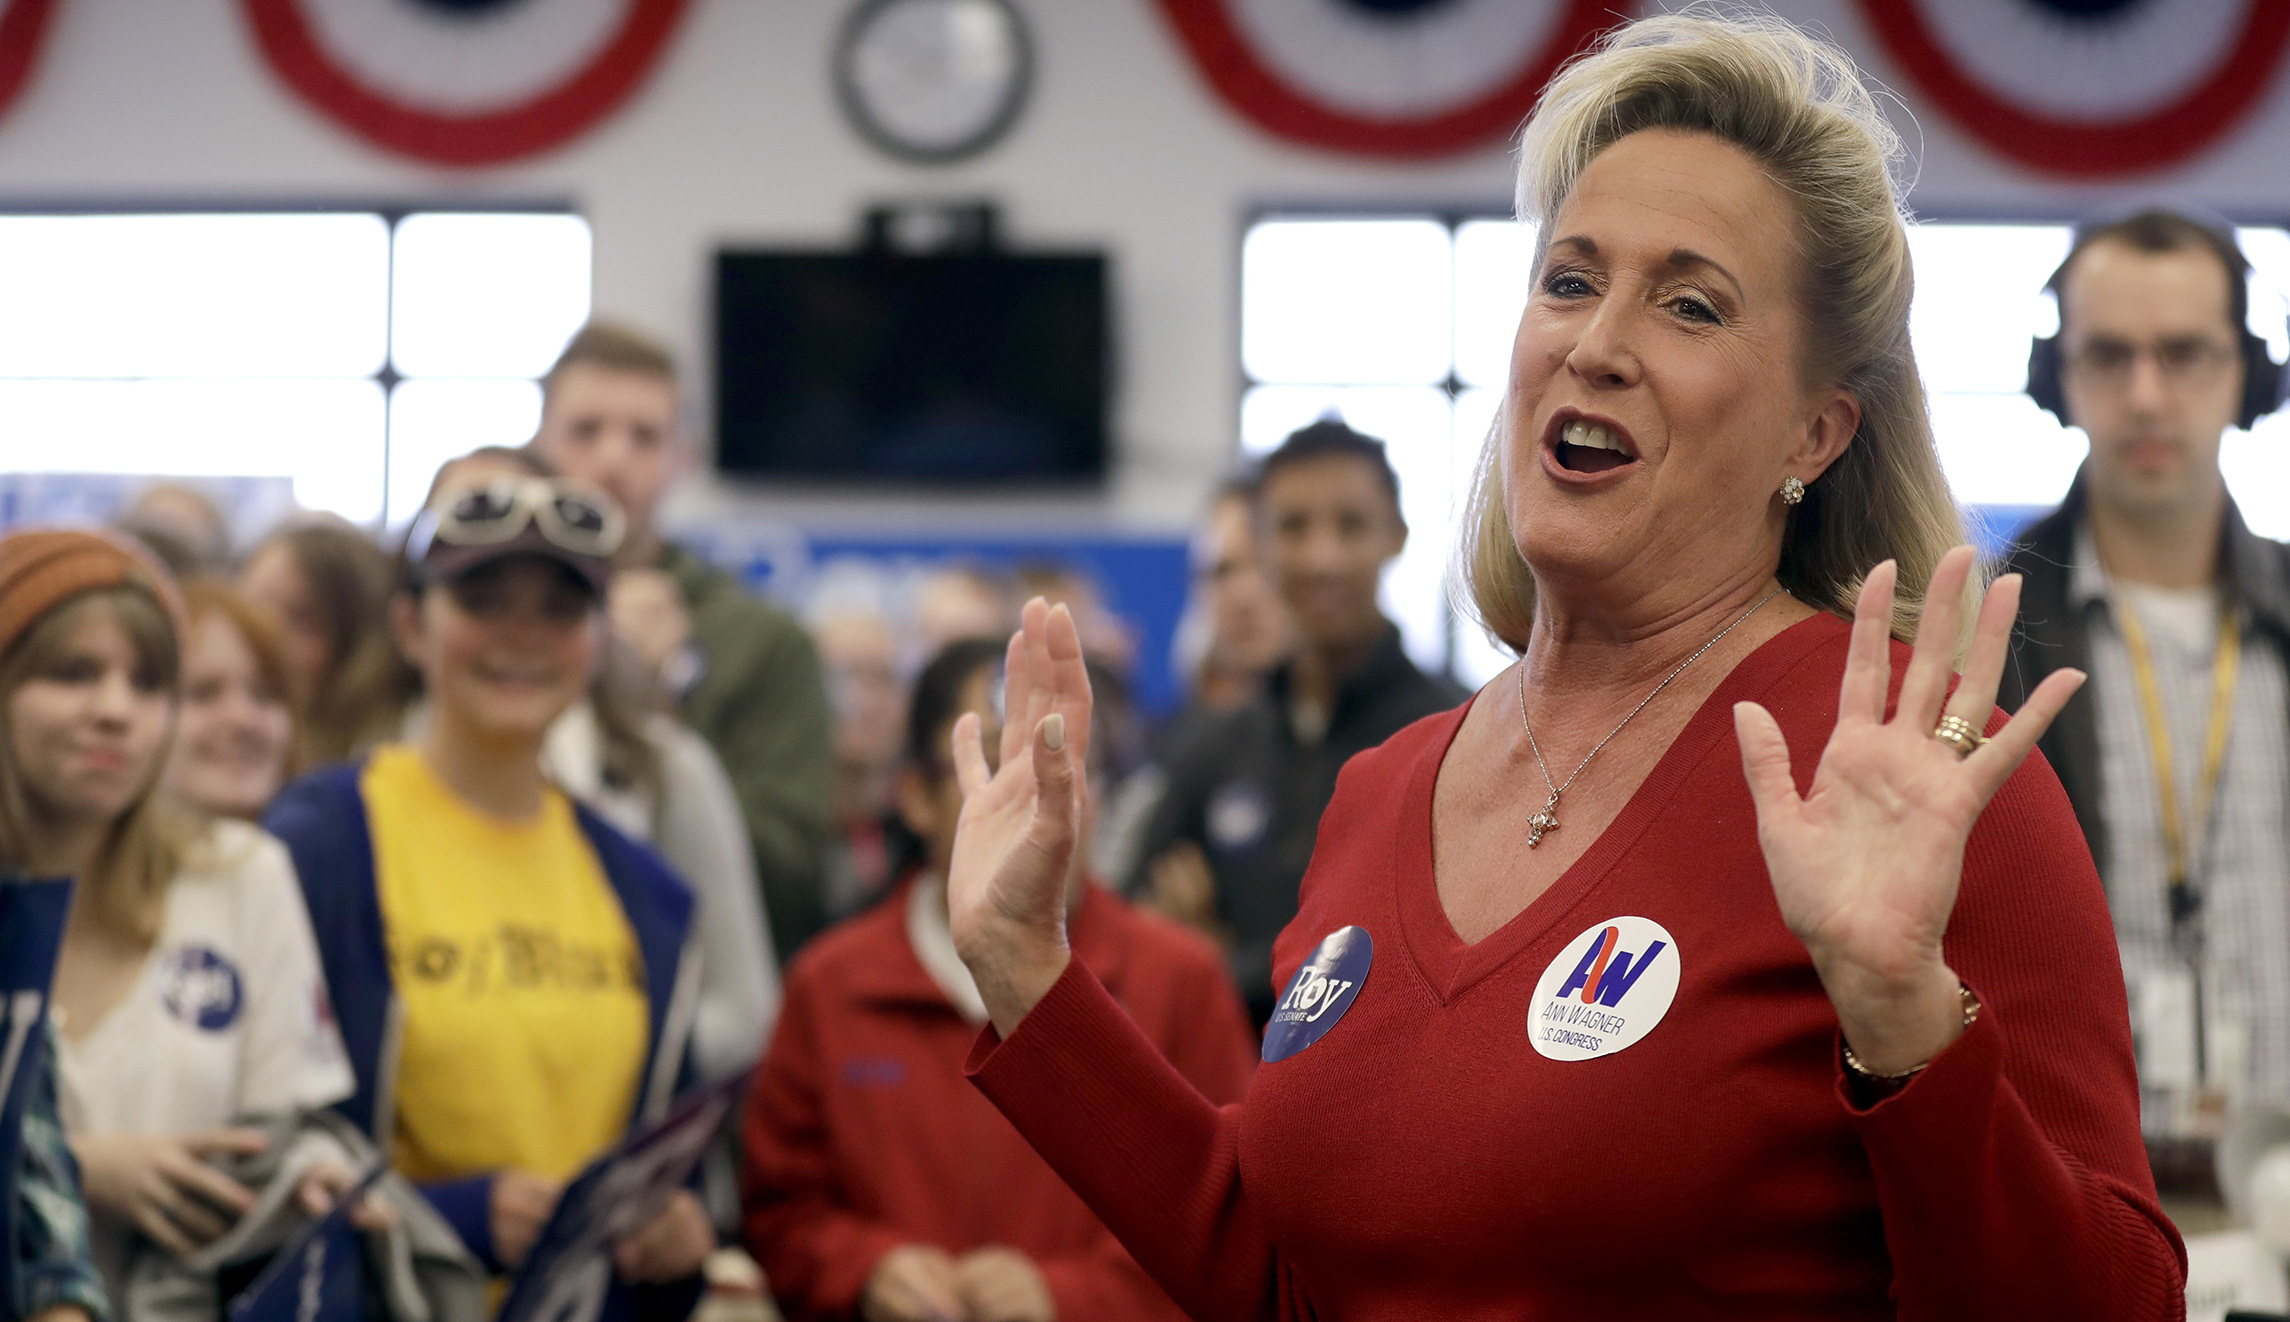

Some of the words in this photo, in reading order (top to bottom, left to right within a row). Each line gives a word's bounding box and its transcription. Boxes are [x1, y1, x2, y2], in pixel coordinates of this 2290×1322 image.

[1281, 966, 1353, 1022] Roy
[1541, 1001, 1570, 1022] ANN
[1567, 1004, 1625, 1036] WAGNER
[1538, 1026, 1554, 1041] U.S.
[1553, 1028, 1602, 1051] CONGRESS
